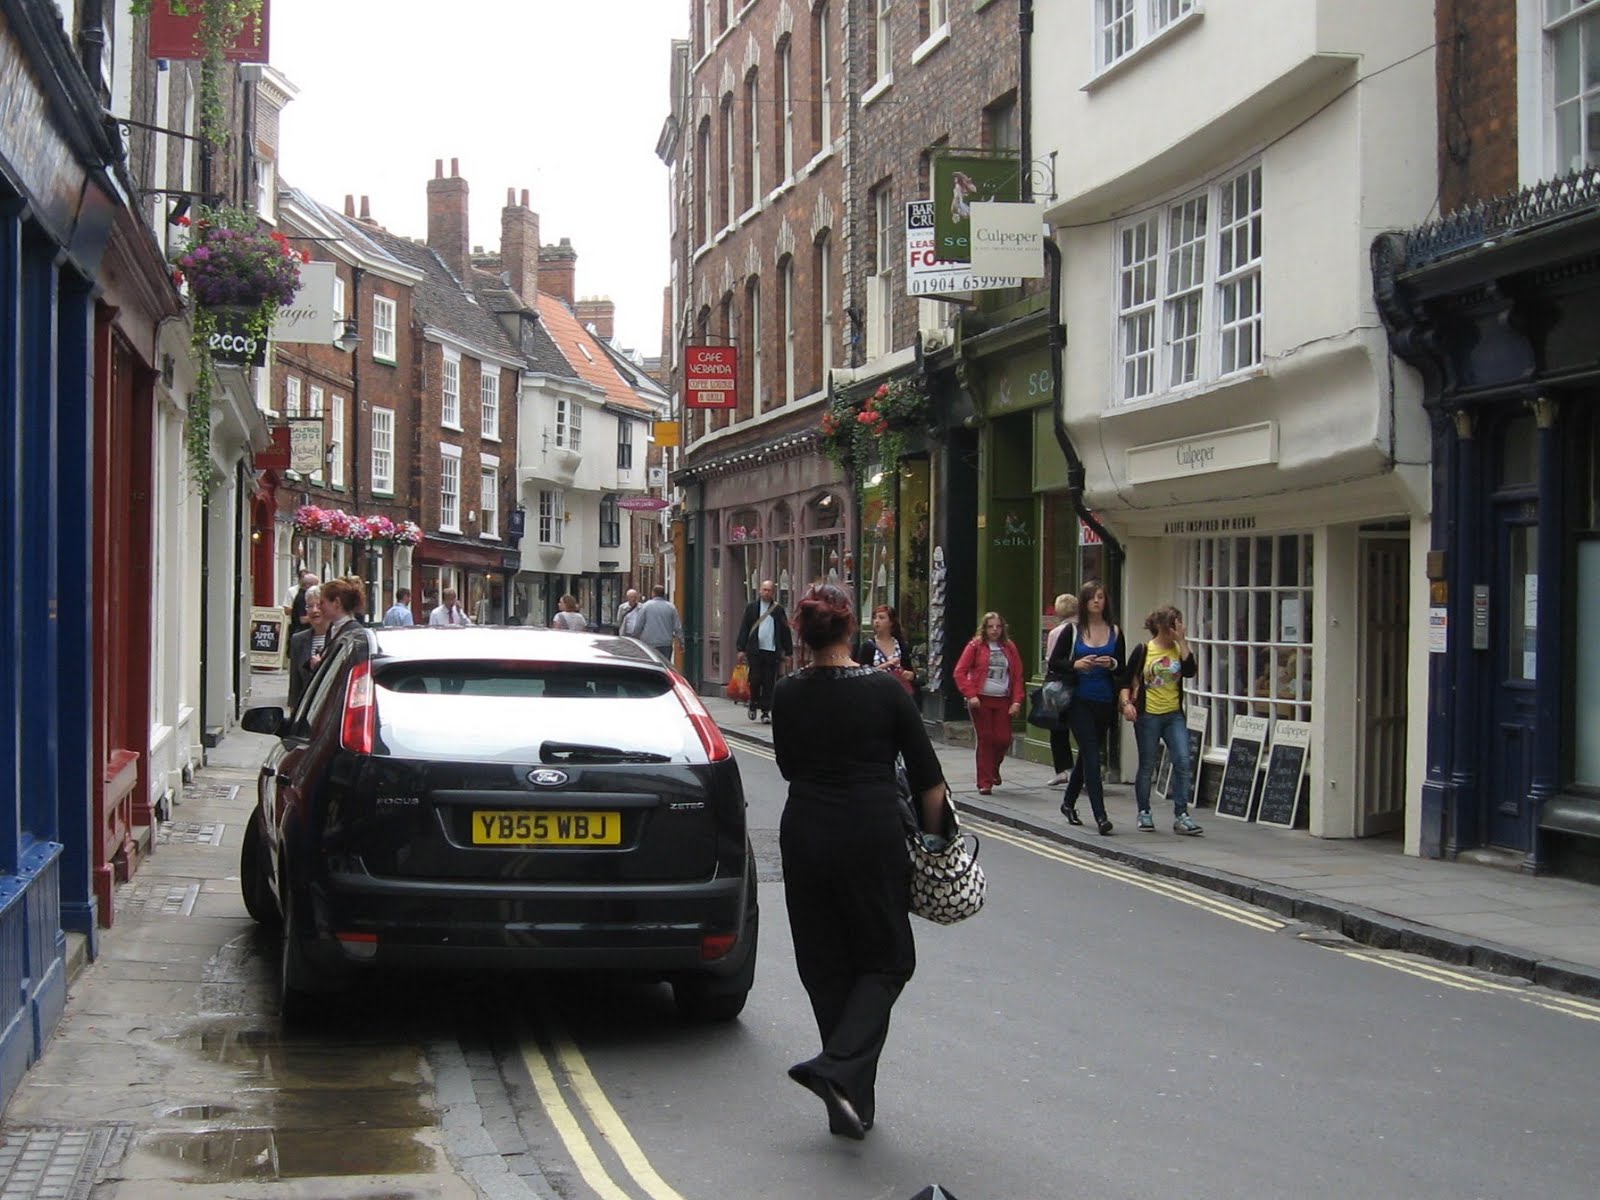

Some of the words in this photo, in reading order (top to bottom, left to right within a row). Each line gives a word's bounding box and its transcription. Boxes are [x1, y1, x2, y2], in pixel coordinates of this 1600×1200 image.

[976, 228, 1037, 245] Culpeper
[910, 250, 955, 268] FO
[912, 278, 955, 294] 01904
[963, 275, 1015, 290] 659990
[208, 332, 257, 355] ecco
[697, 352, 724, 363] CAFE
[689, 363, 732, 375] VERANDA
[1176, 445, 1215, 469] Culpeper
[1164, 522, 1169, 534] A
[1170, 521, 1184, 534] LIFE
[1186, 519, 1219, 533] INSPIRED
[1221, 518, 1230, 531] BY
[1232, 515, 1257, 530] HERBS
[536, 771, 559, 784] Ford
[376, 797, 420, 806] FOCUS
[669, 801, 705, 811] ZETEC
[480, 815, 549, 840] YB55
[557, 815, 607, 840] WBJ
